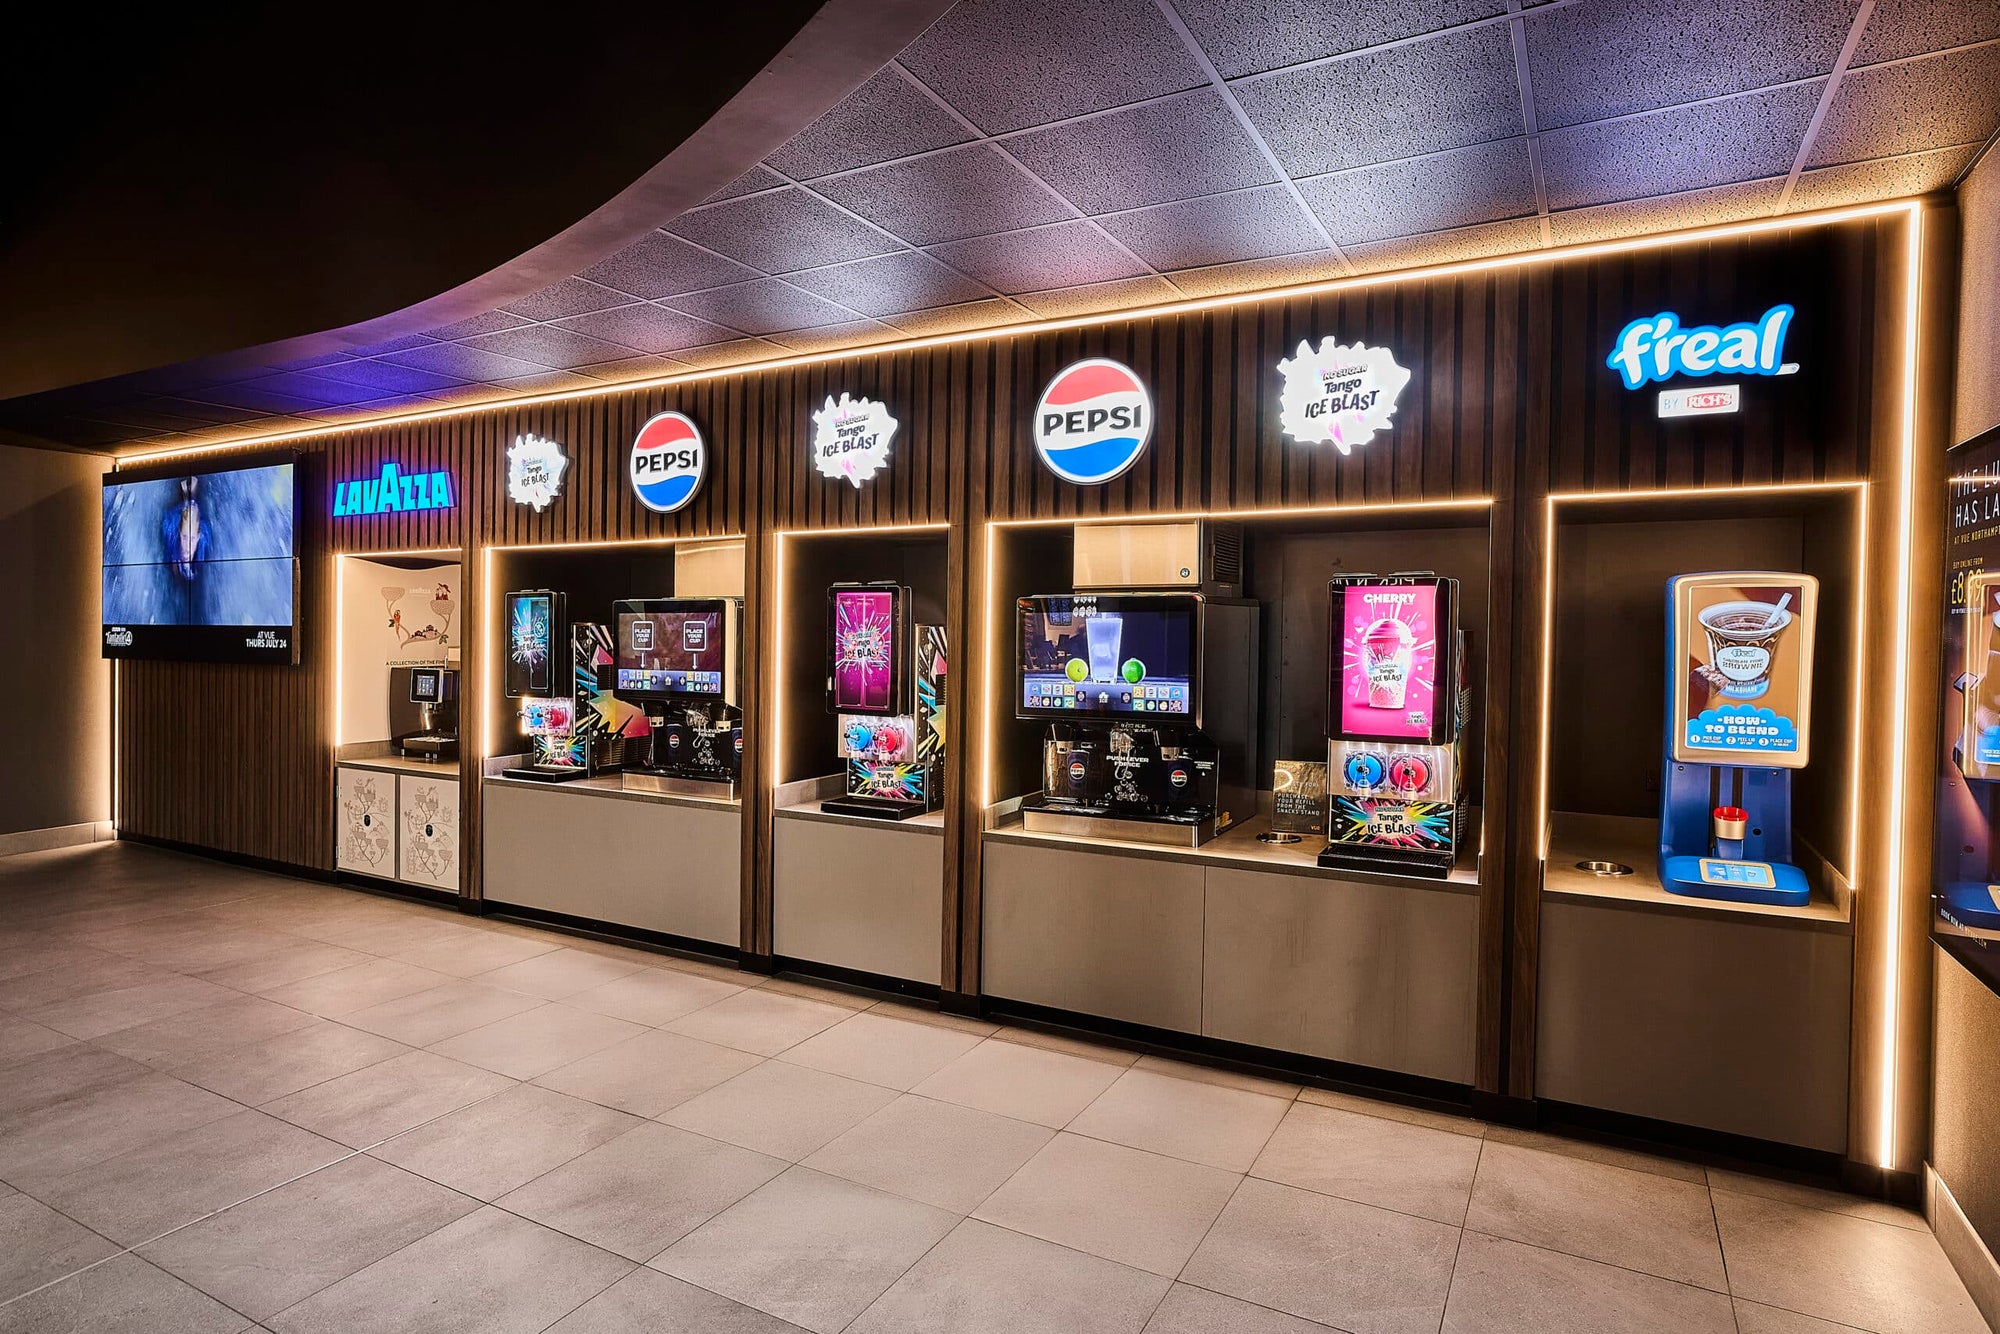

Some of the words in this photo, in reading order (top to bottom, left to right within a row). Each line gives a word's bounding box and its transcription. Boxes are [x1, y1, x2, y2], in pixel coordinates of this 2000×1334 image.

[1612, 309, 1789, 386] f'real
[1324, 378, 1362, 394] Tango
[1305, 398, 1328, 418] ICE
[1331, 390, 1380, 414] BLAST
[1663, 398, 1679, 410] BY
[1687, 394, 1732, 408] RICH'S
[1043, 405, 1142, 436] PEPSI
[836, 424, 865, 438] Tango
[823, 441, 840, 457] ICE
[842, 433, 880, 453] BLAST
[635, 449, 698, 475] PEPSI
[521, 476, 530, 488] ICE
[531, 473, 550, 485] BLAST
[1957, 468, 1978, 498] THE
[333, 463, 452, 517] LAVAZZA
[1955, 500, 1978, 529] HAS
[1363, 593, 1416, 603] CHERRY
[246, 638, 265, 648] THURS
[265, 639, 279, 648] JULY
[279, 639, 287, 648] 24
[264, 631, 275, 640] VUE
[1704, 724, 1725, 733] TO
[1727, 725, 1779, 736] BLEND
[871, 780, 881, 788] ICE
[882, 780, 902, 789] BLAST
[1277, 792, 1309, 800] PURCHASE
[1377, 813, 1403, 823] Tango
[1367, 823, 1383, 834] ICE
[1385, 823, 1416, 835] BLAST
